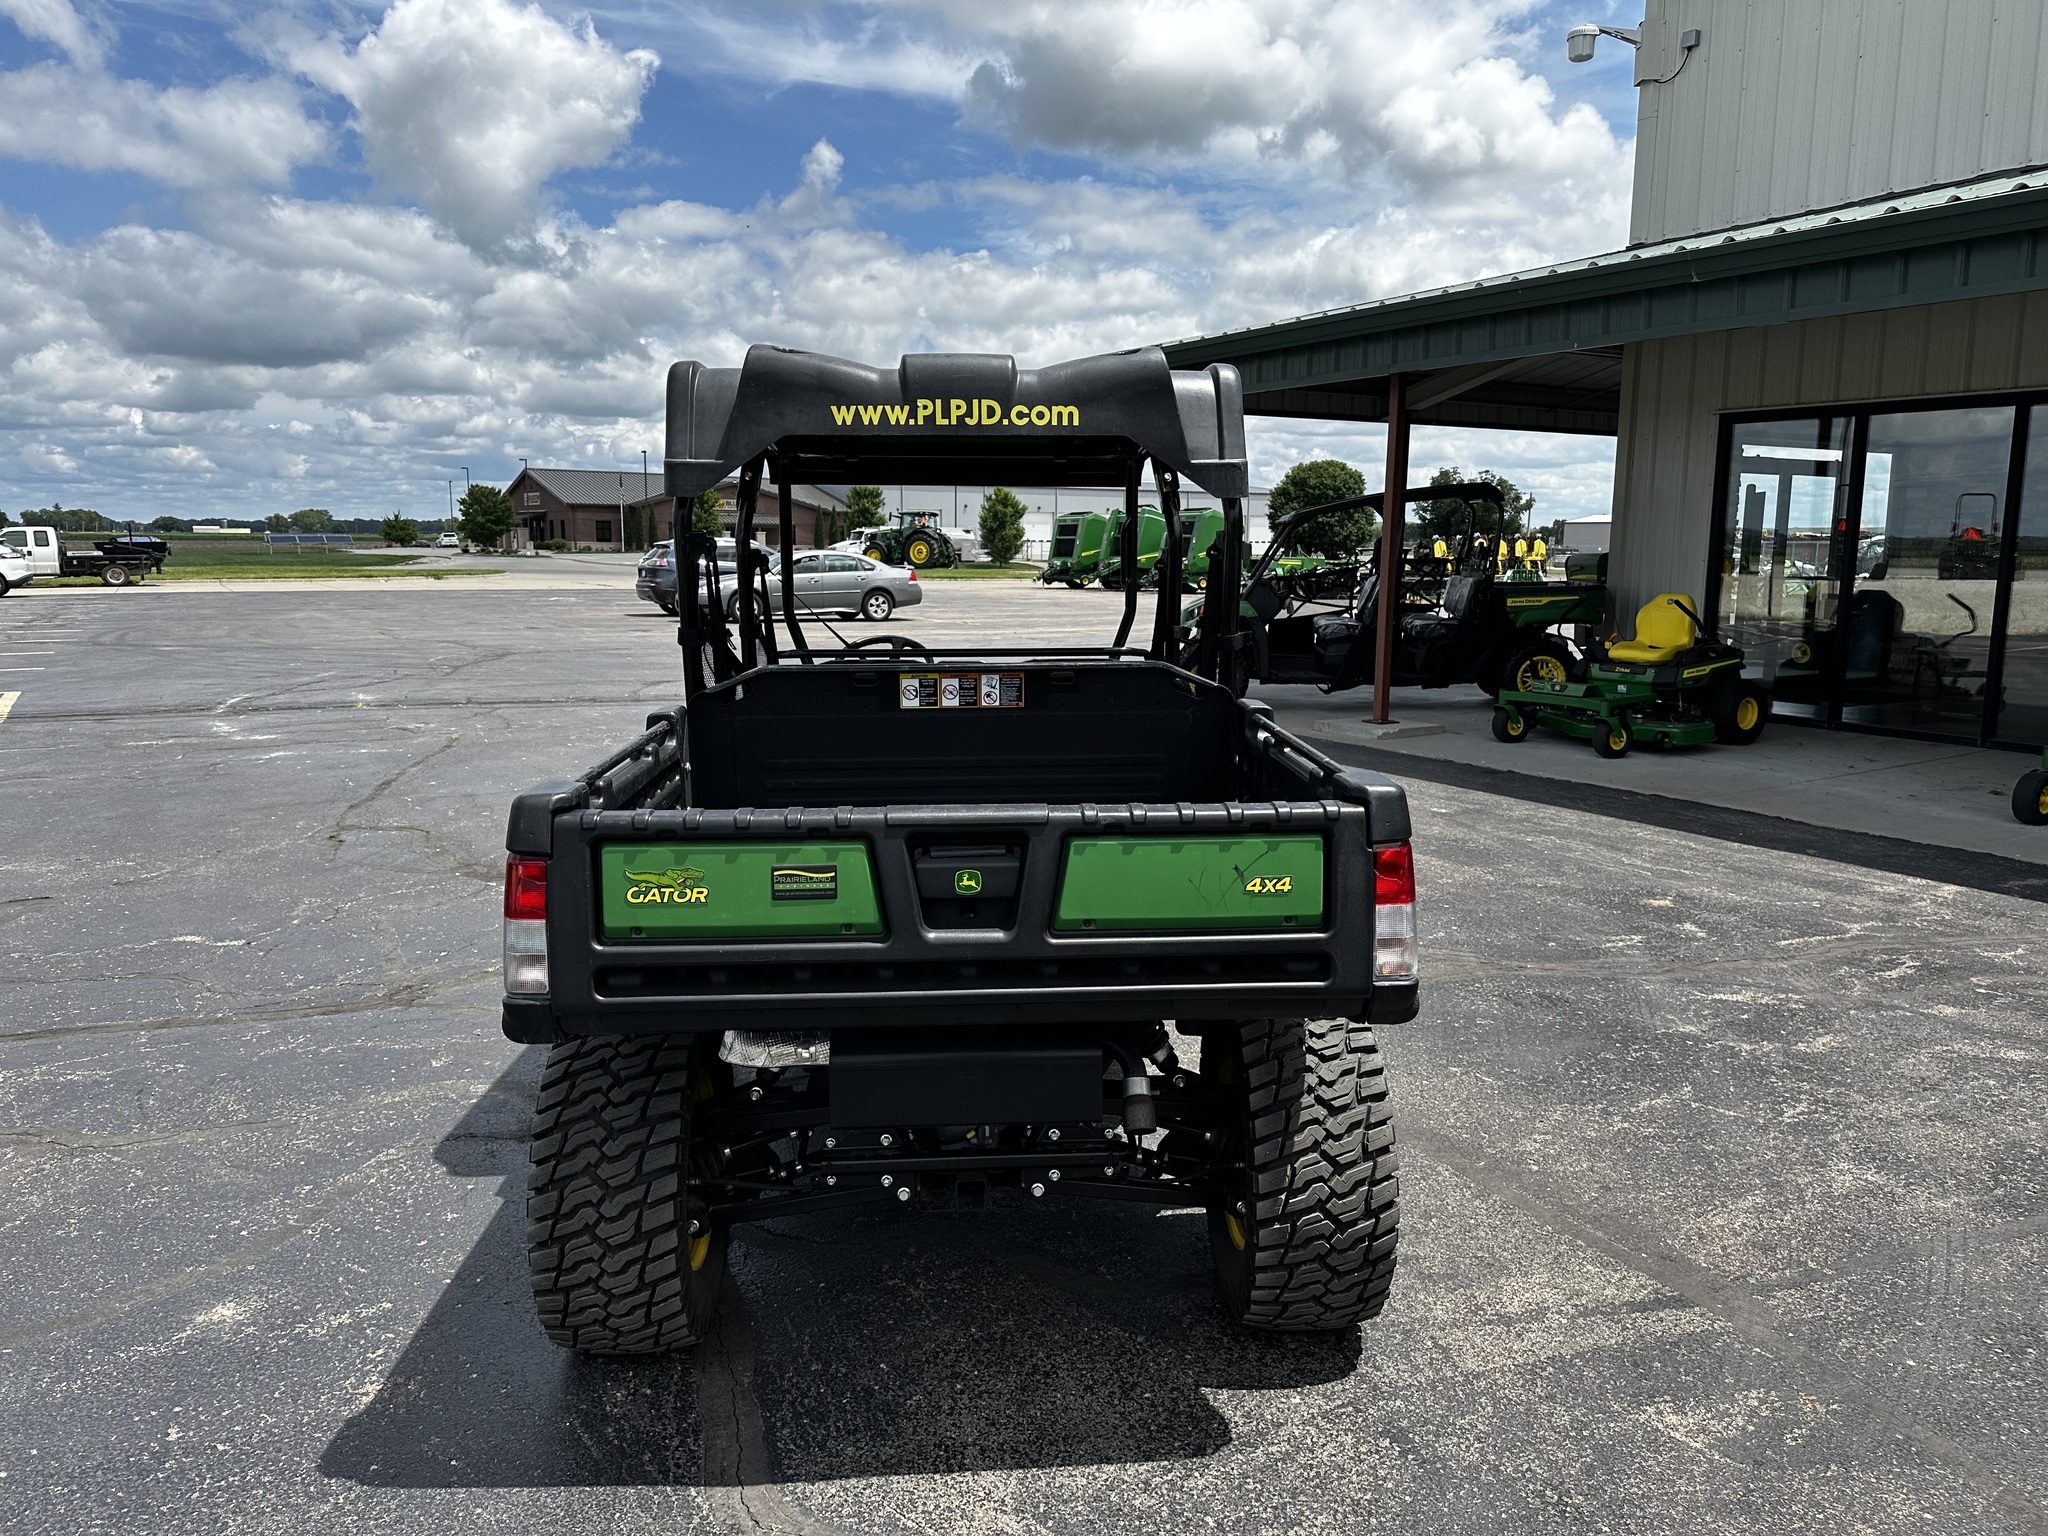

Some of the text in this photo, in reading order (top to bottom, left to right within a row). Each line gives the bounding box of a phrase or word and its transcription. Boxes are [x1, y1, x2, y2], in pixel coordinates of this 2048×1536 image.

[830, 398, 1080, 427] www.PLPJD.com
[1245, 876, 1293, 894] 4x4
[626, 887, 709, 904] GATOR
